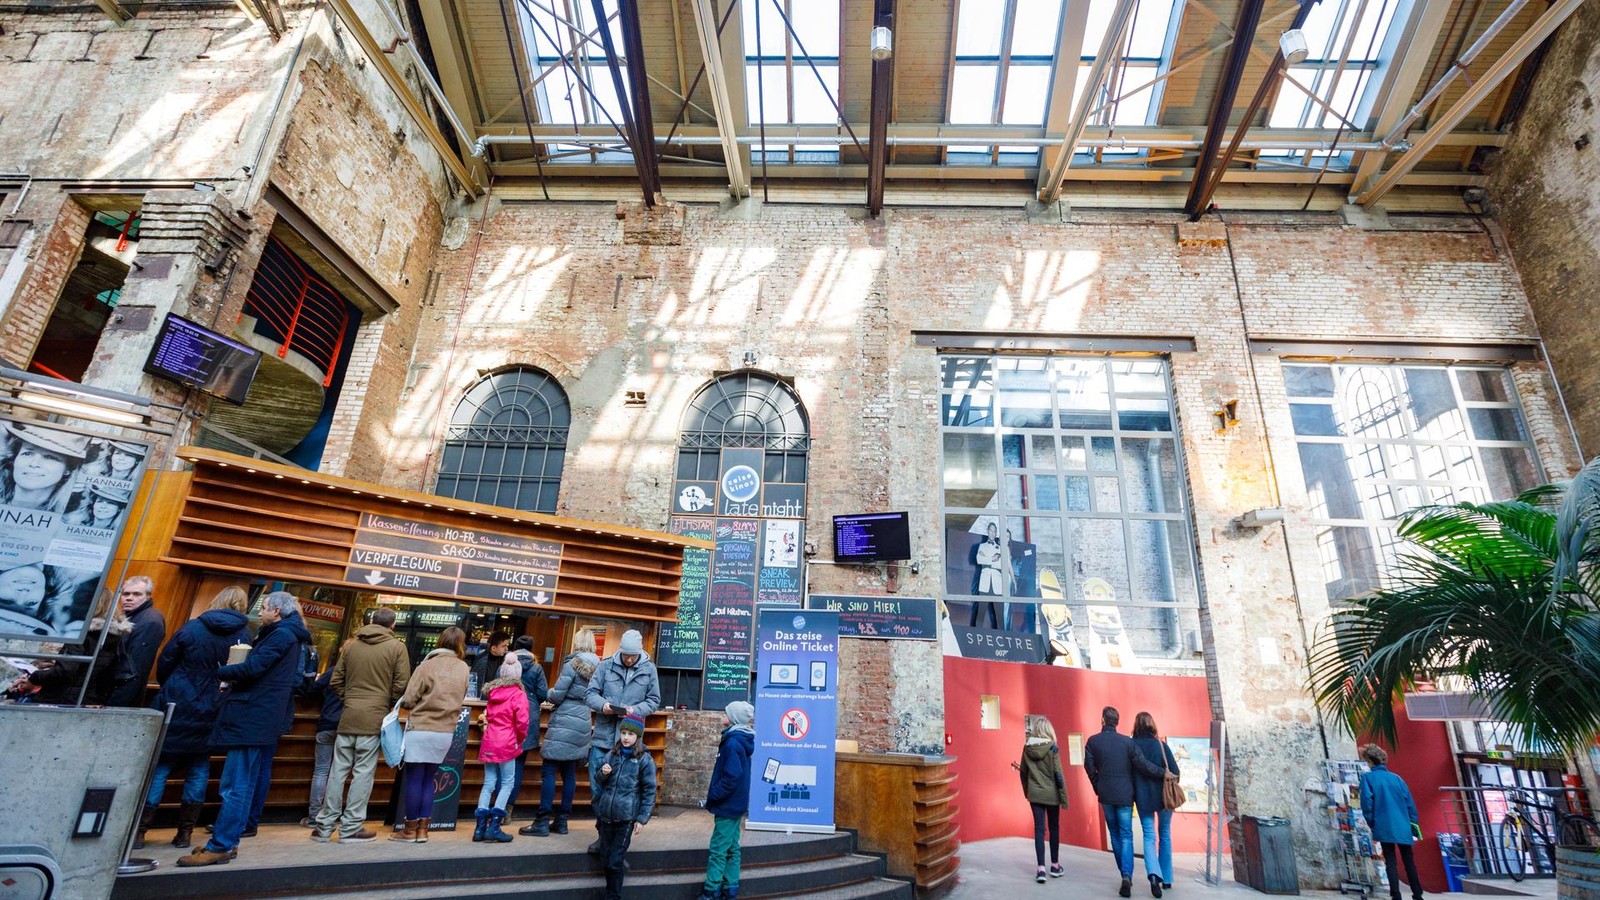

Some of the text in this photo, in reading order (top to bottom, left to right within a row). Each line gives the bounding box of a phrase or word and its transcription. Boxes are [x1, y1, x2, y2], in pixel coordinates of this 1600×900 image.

[86, 476, 131, 488] HANNAH
[727, 473, 752, 486] zeise
[729, 480, 754, 492] kinos
[724, 499, 803, 517] late night
[66, 526, 113, 539] HANNAH
[723, 543, 753, 553] ORIGINAL
[355, 550, 442, 573] VERPFLEGUNG
[722, 552, 751, 560] TUESDAY
[393, 573, 420, 588] HIER
[493, 568, 545, 587] TICKETS
[760, 569, 791, 579] SNEAK
[760, 579, 797, 588] PREVIEW
[502, 587, 530, 602] HIER
[826, 600, 901, 613] WIR SIND HIER!
[775, 631, 822, 640] Das zeise
[966, 633, 1033, 650] SPECTRE
[763, 641, 834, 652] Online Ticket
